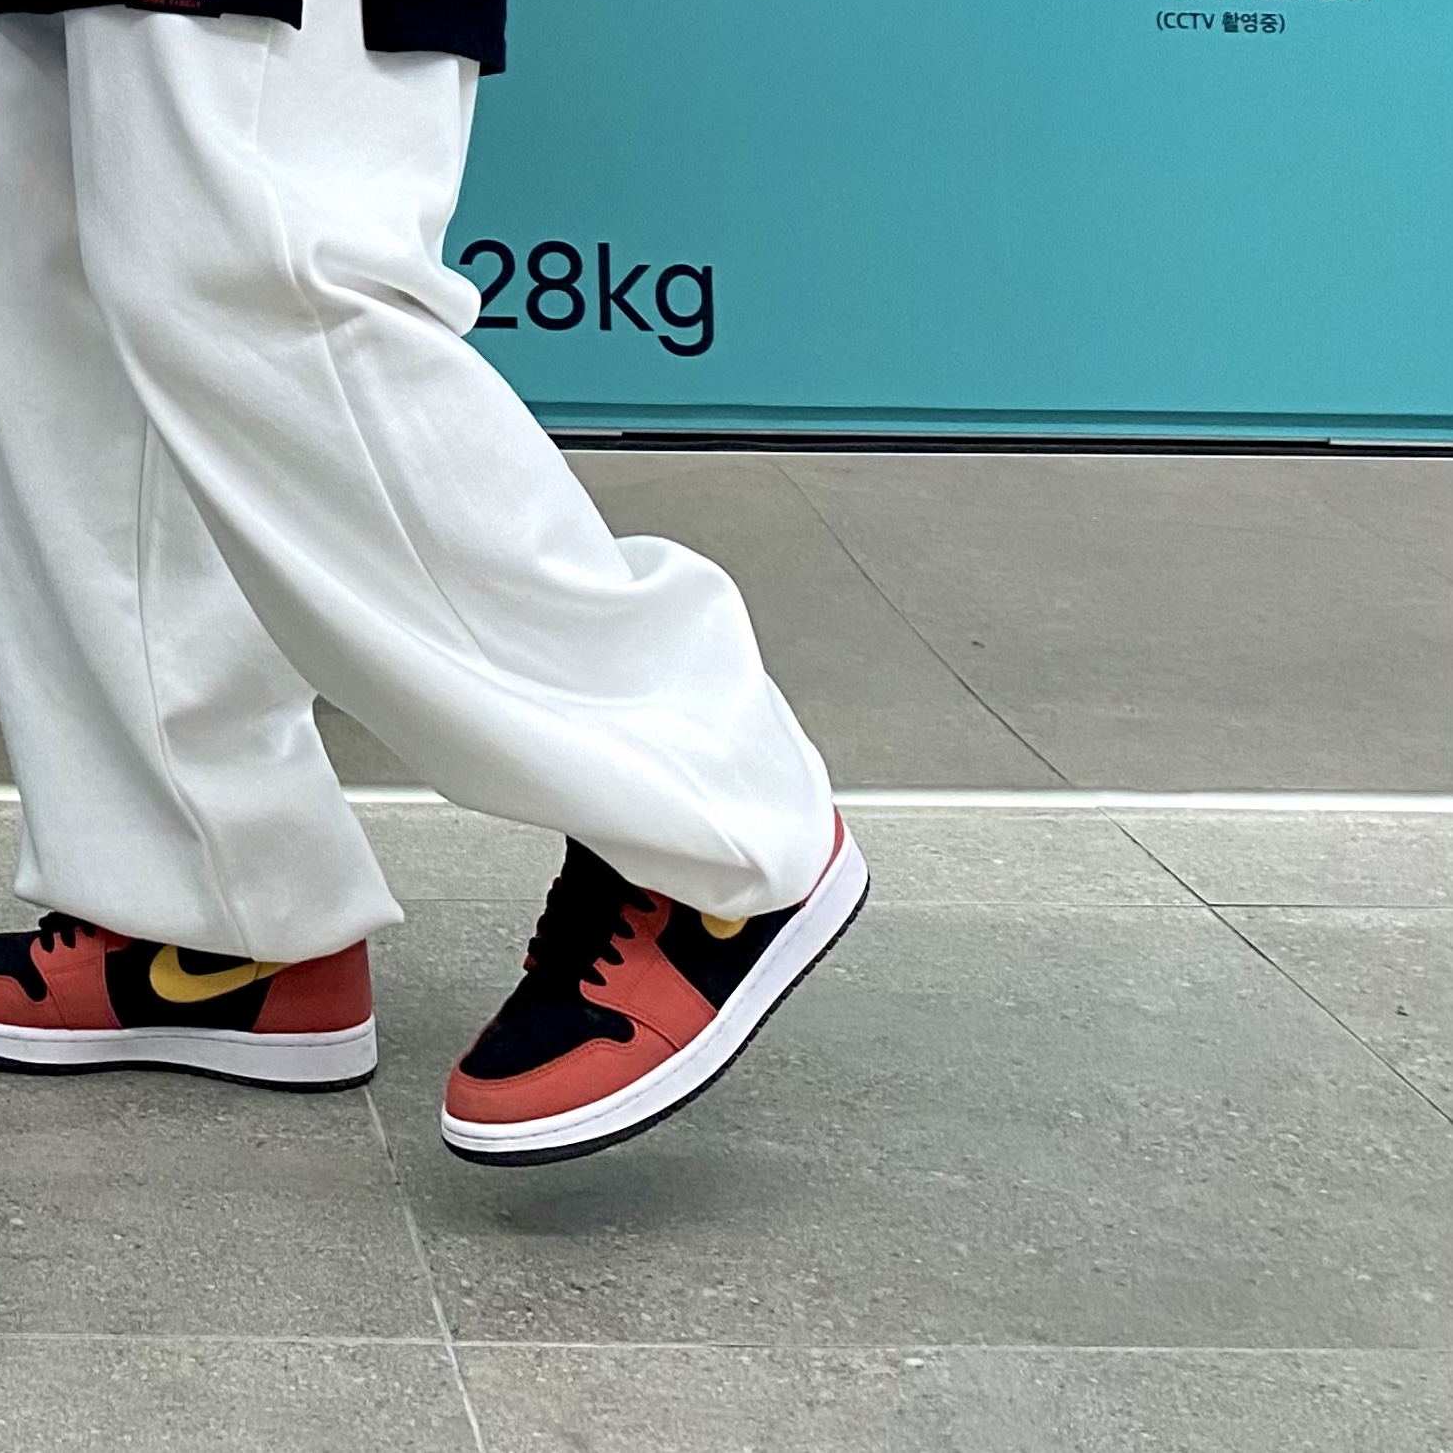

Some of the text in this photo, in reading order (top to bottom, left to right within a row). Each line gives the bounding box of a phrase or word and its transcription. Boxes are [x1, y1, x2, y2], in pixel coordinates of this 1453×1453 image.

[1156, 11, 1286, 33] (CCTV 촬영중)
[459, 239, 714, 357] 28kg
